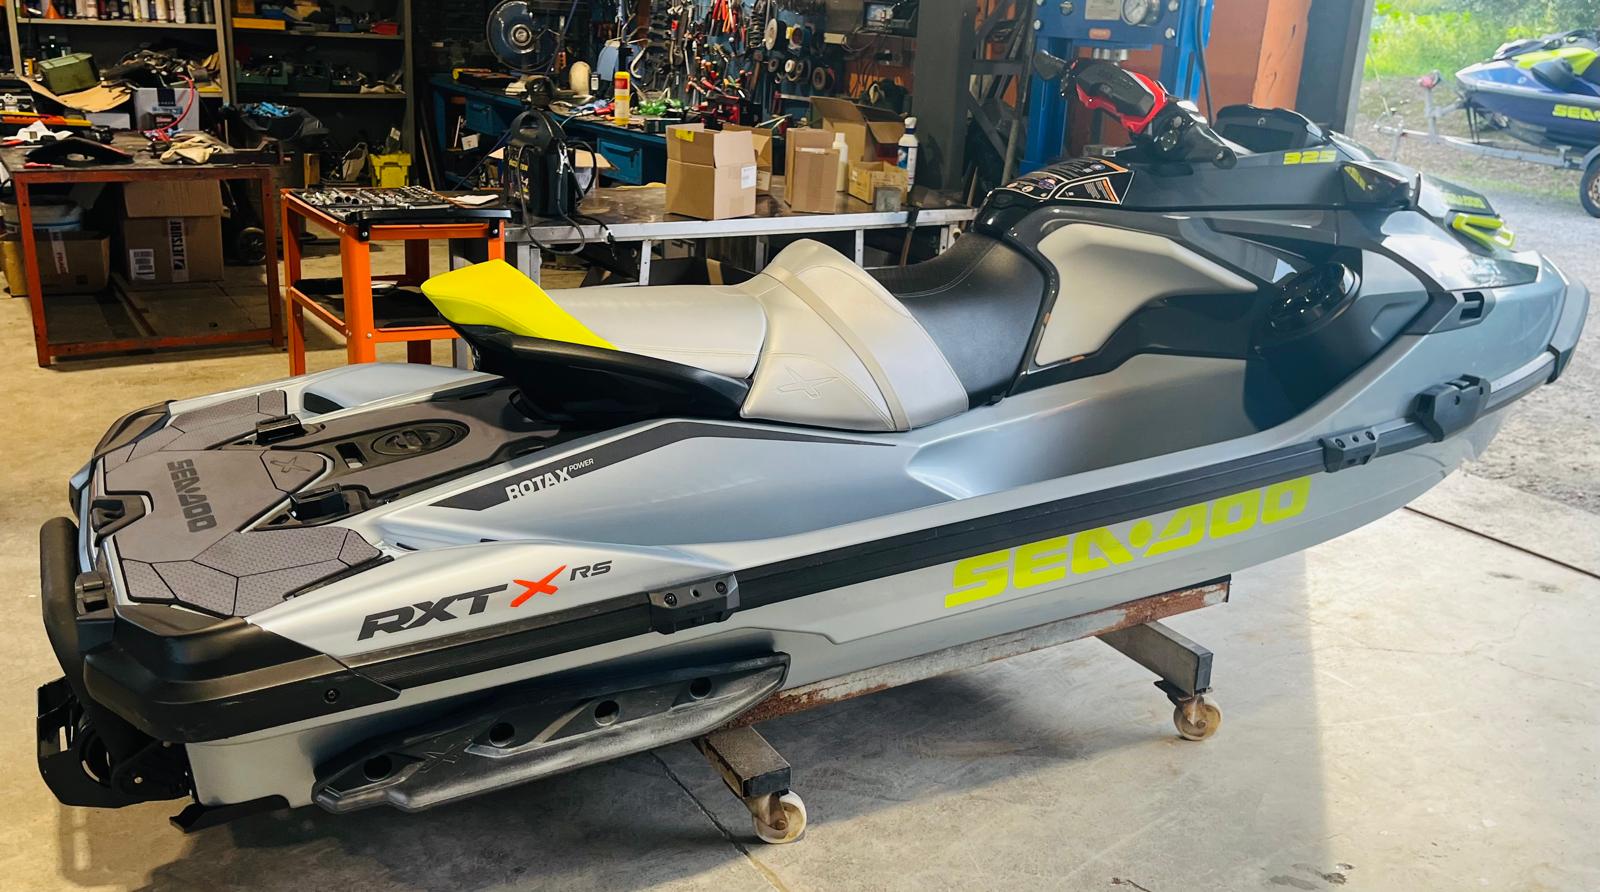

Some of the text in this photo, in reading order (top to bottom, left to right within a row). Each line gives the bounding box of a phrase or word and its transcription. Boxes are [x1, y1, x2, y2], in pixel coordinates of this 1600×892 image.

[1283, 150, 1337, 165] 325
[170, 221, 185, 258] JETSURF
[505, 458, 594, 502] ROTAX POWER
[357, 583, 509, 642] RXT
[569, 560, 613, 582] RS
